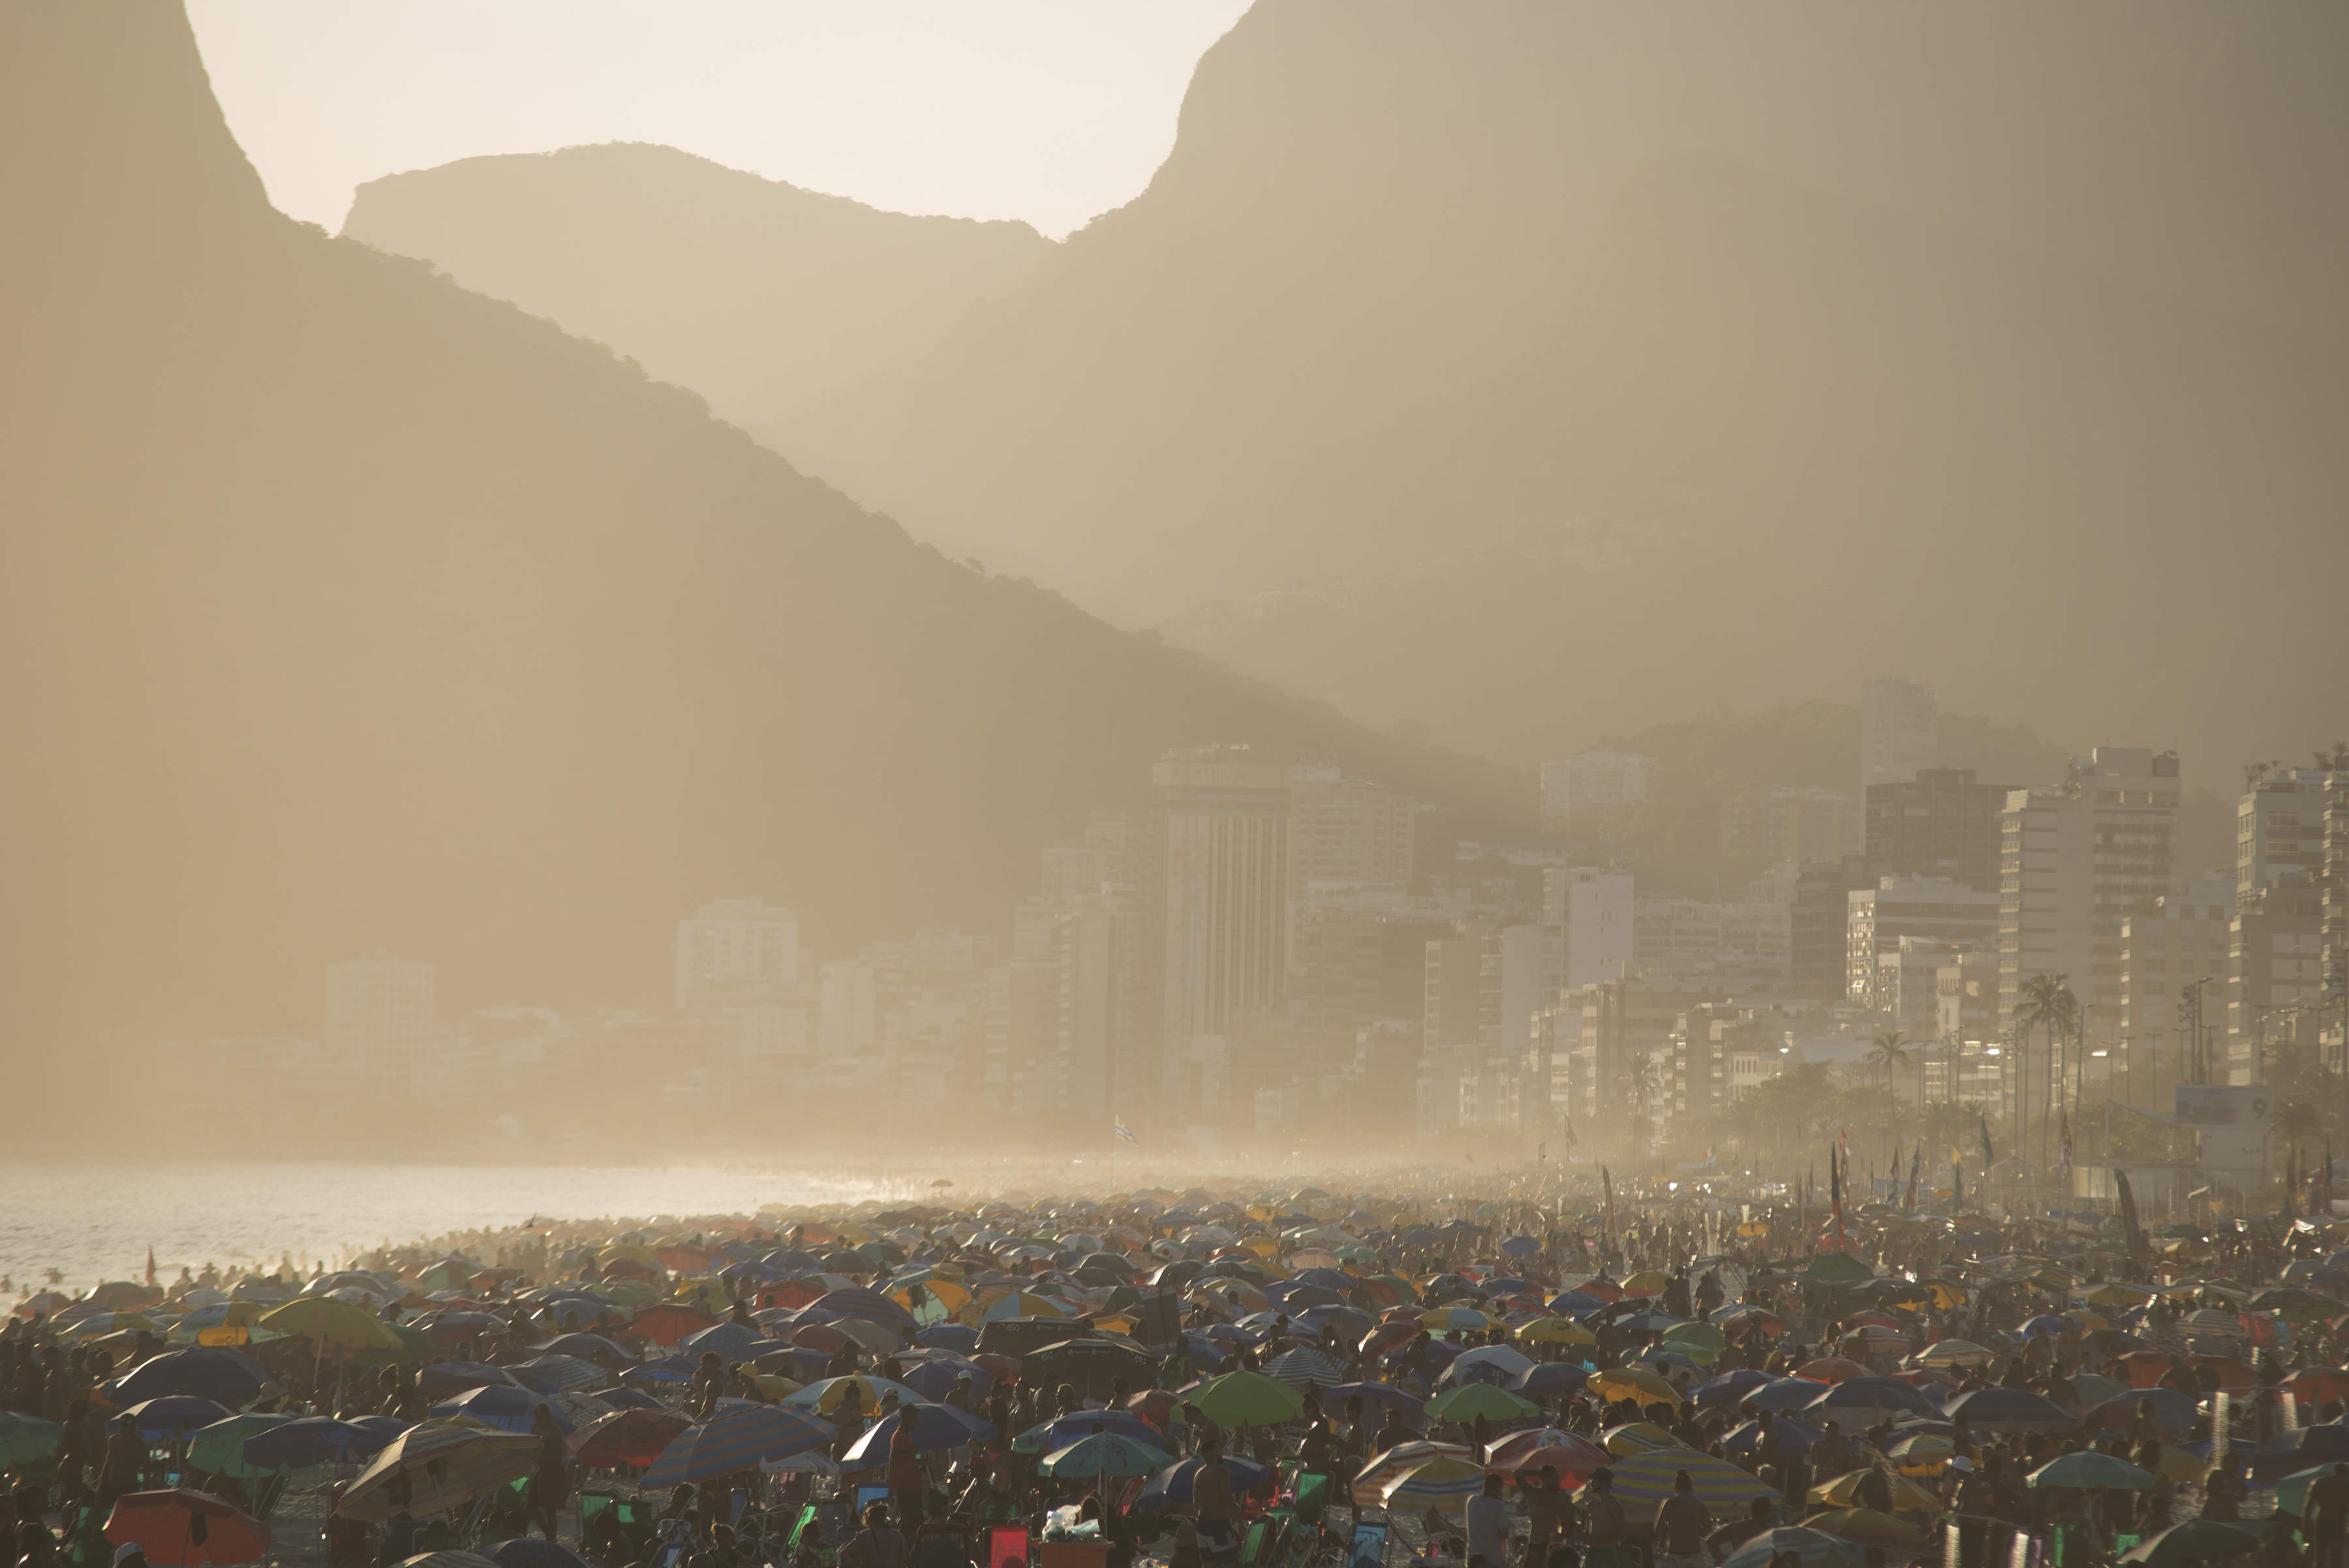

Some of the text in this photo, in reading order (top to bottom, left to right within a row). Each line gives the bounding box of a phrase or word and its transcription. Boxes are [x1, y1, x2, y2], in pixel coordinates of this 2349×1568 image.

[1175, 766, 1246, 783] MARINA
[2253, 1098, 2267, 1120] 9
[1041, 1351, 1053, 1361] elo
[1134, 1355, 1147, 1365] elo
